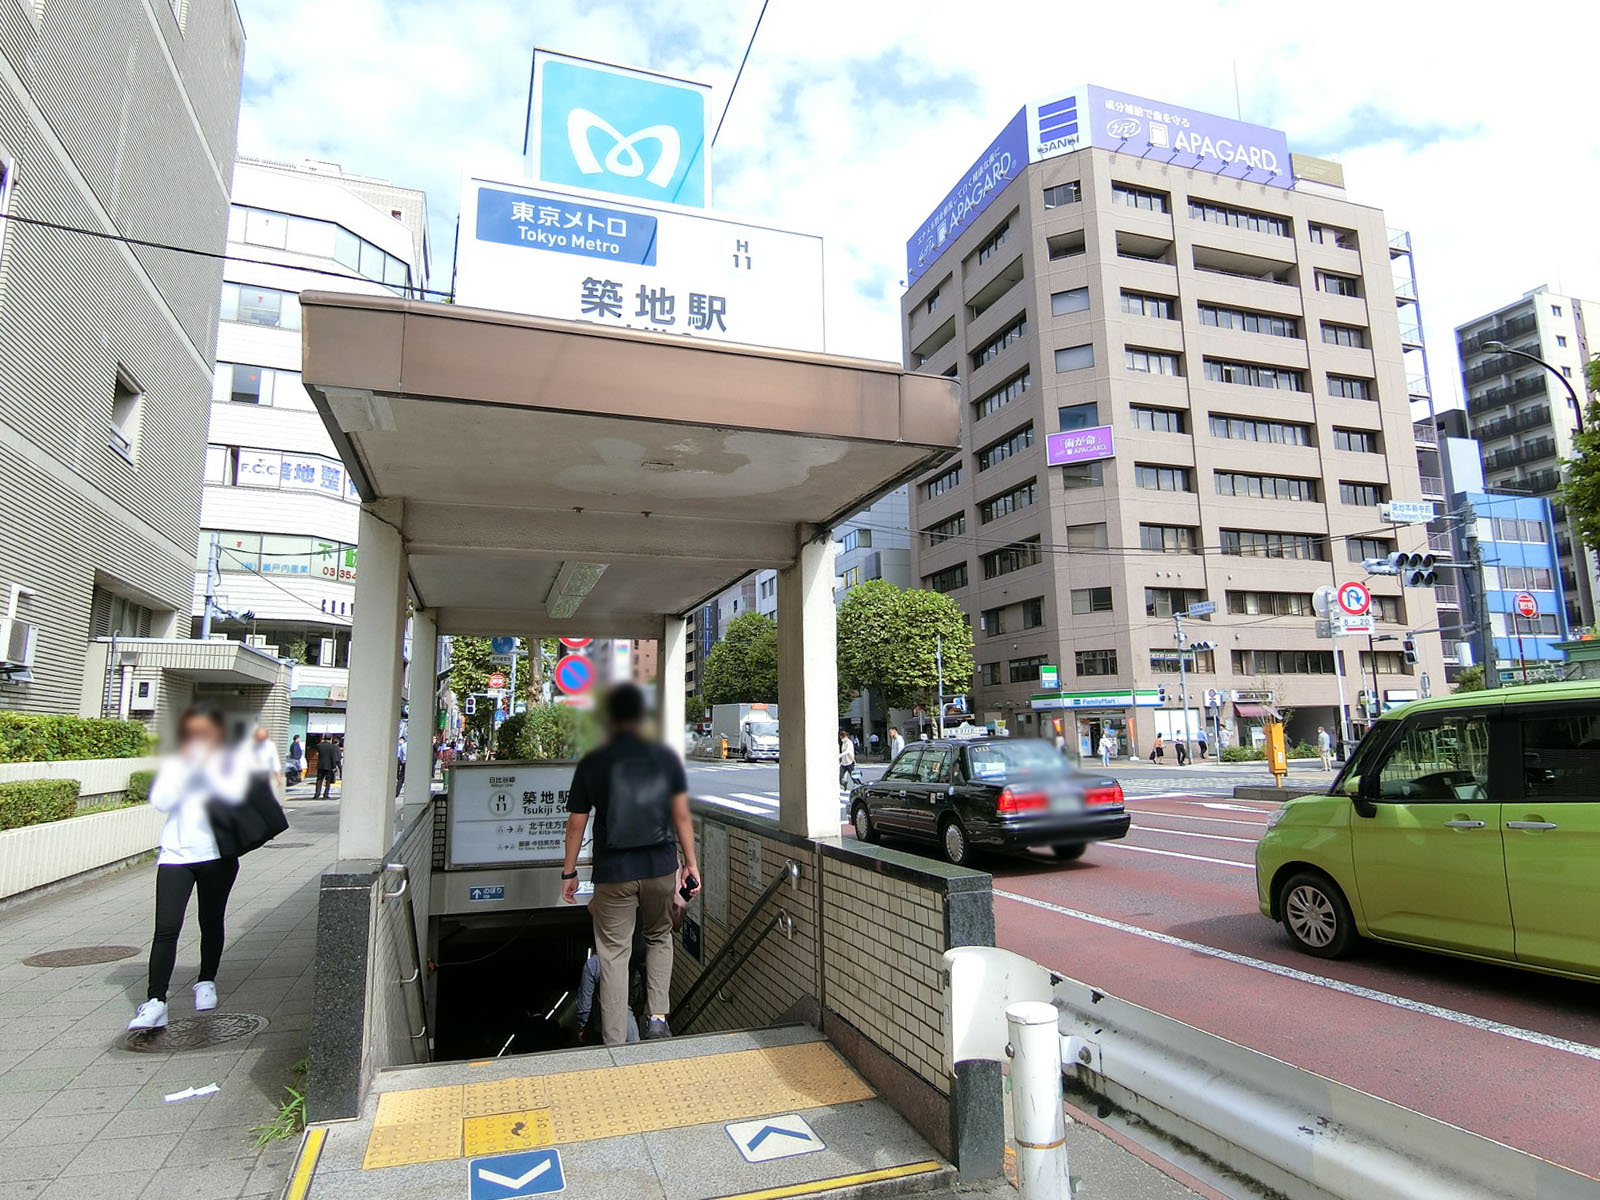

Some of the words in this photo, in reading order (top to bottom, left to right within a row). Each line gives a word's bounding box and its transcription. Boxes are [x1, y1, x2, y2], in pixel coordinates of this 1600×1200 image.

[1174, 130, 1277, 171] APAGARD
[511, 201, 627, 238] 東京メトロ
[518, 225, 567, 247] Tokyo
[571, 234, 620, 254] Metro
[736, 239, 749, 253] H
[733, 254, 752, 270] 11
[581, 276, 727, 333] 築地駅
[498, 794, 506, 802] H
[496, 803, 507, 811] 11
[522, 804, 553, 816] Tsukiji
